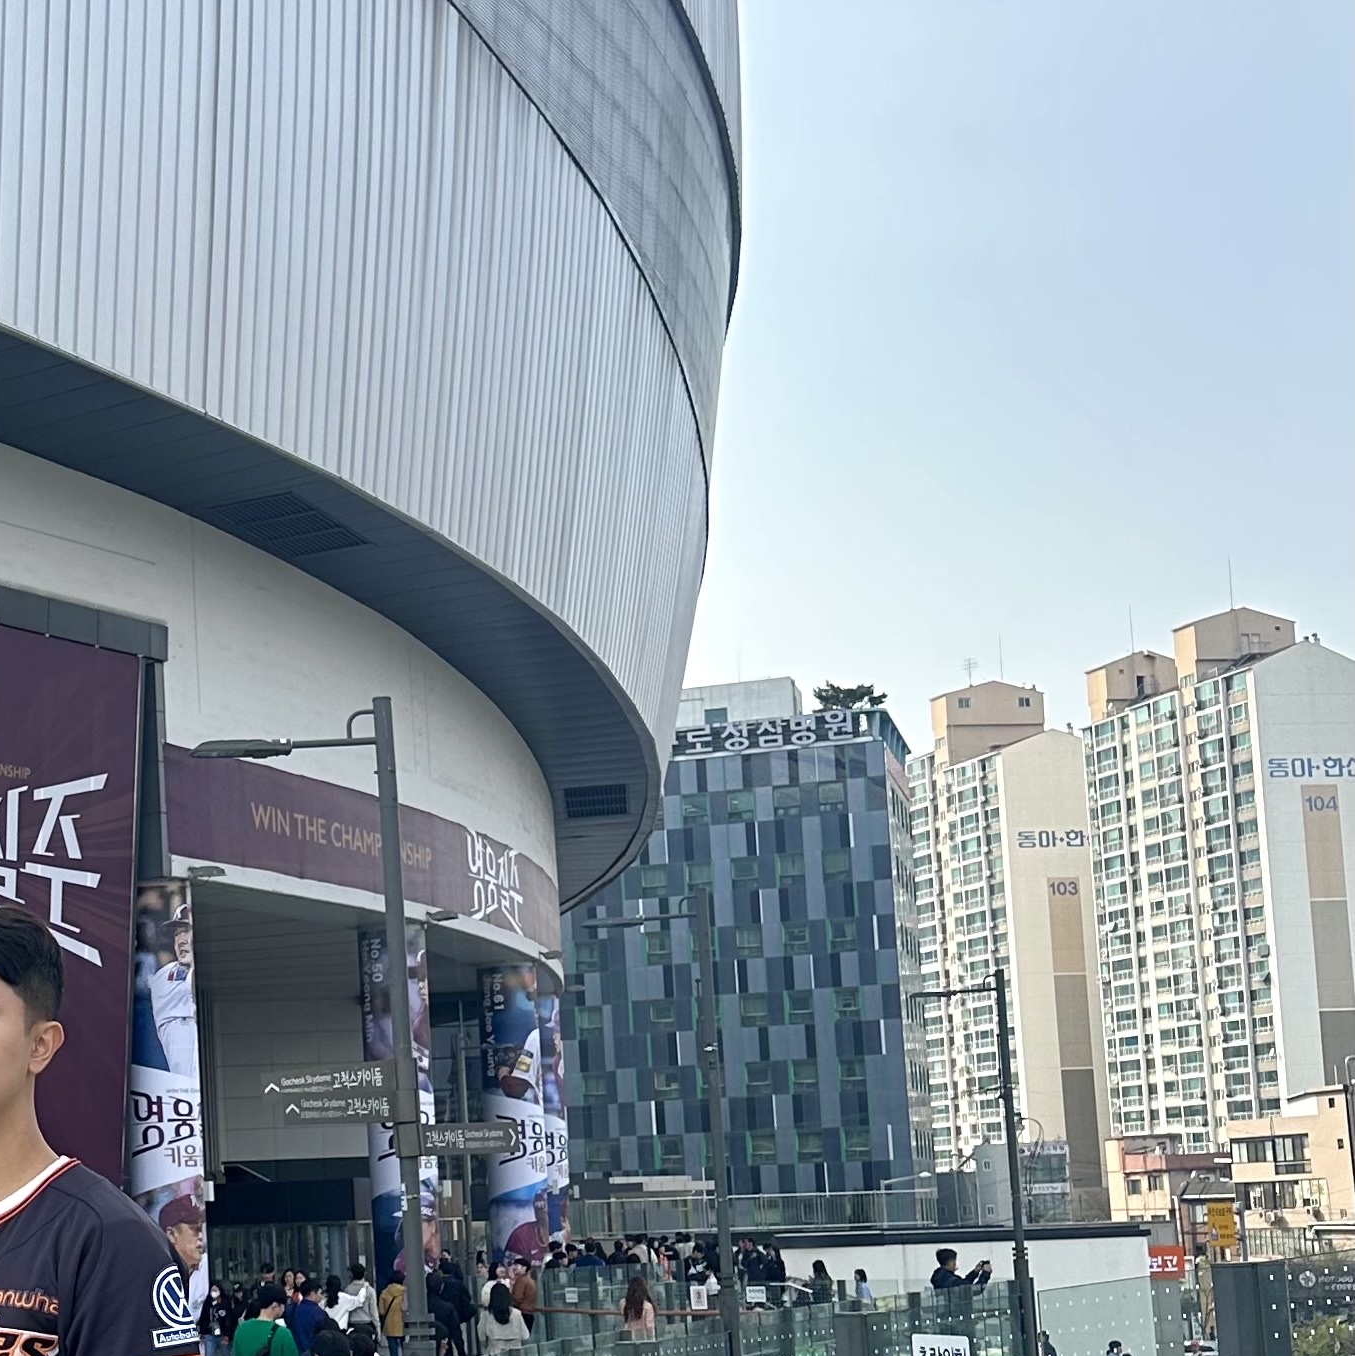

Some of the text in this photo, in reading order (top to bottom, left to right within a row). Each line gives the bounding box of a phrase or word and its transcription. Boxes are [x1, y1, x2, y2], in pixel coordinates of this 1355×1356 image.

[672, 708, 853, 754] 로성심병원
[1305, 795, 1337, 812] 104
[251, 802, 432, 869] WIN THE CHAMPNSHIP
[1017, 829, 1090, 848] 동아·한
[1049, 881, 1078, 896] 103
[332, 1067, 384, 1089] 고척스카이돔
[346, 1097, 390, 1117] 고척스카이돔
[129, 1089, 202, 1158] 영웅
[164, 1144, 202, 1168] 키움
